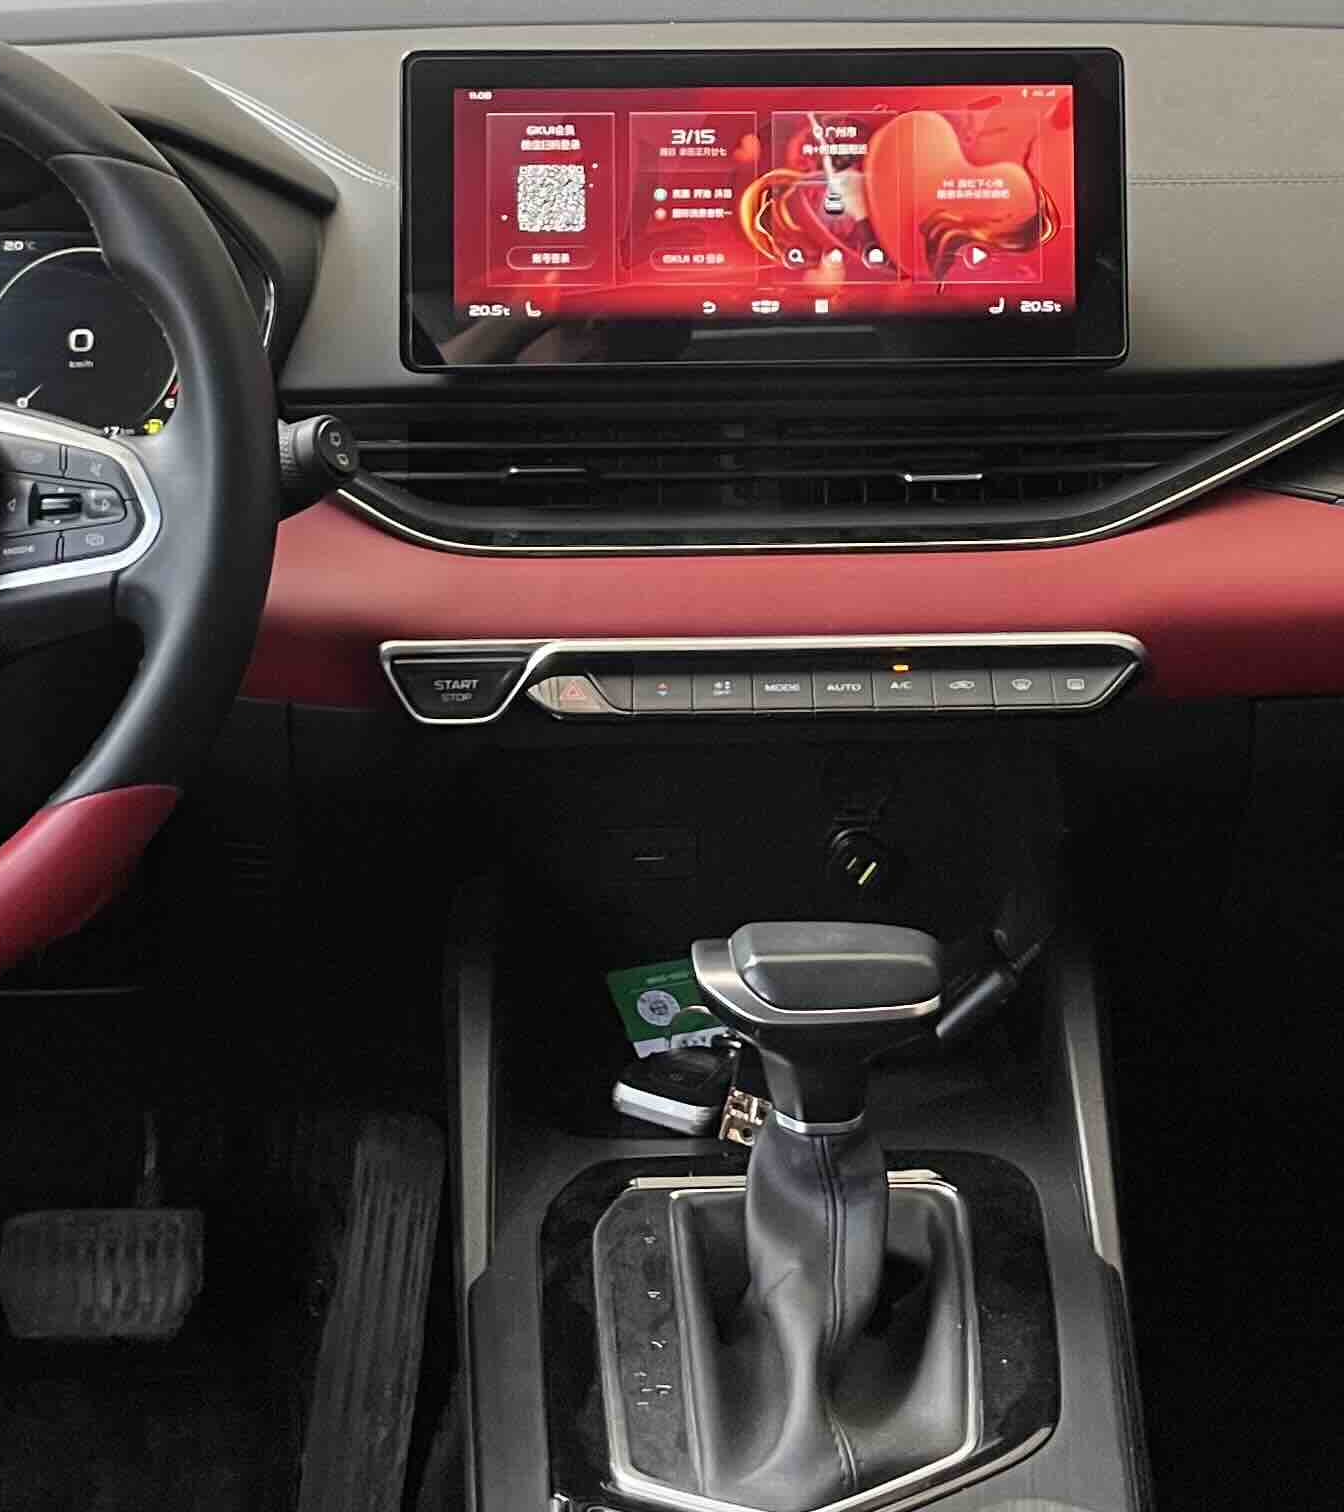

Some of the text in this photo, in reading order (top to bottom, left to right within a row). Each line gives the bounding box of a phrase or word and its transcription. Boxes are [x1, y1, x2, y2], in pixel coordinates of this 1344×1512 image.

[672, 129, 716, 144] 3/15
[68, 328, 94, 352] 0
[433, 679, 480, 691] START
[764, 682, 801, 692] MODE
[826, 682, 862, 692] AUTO
[890, 680, 912, 689] A/C
[441, 692, 473, 702] STOP
